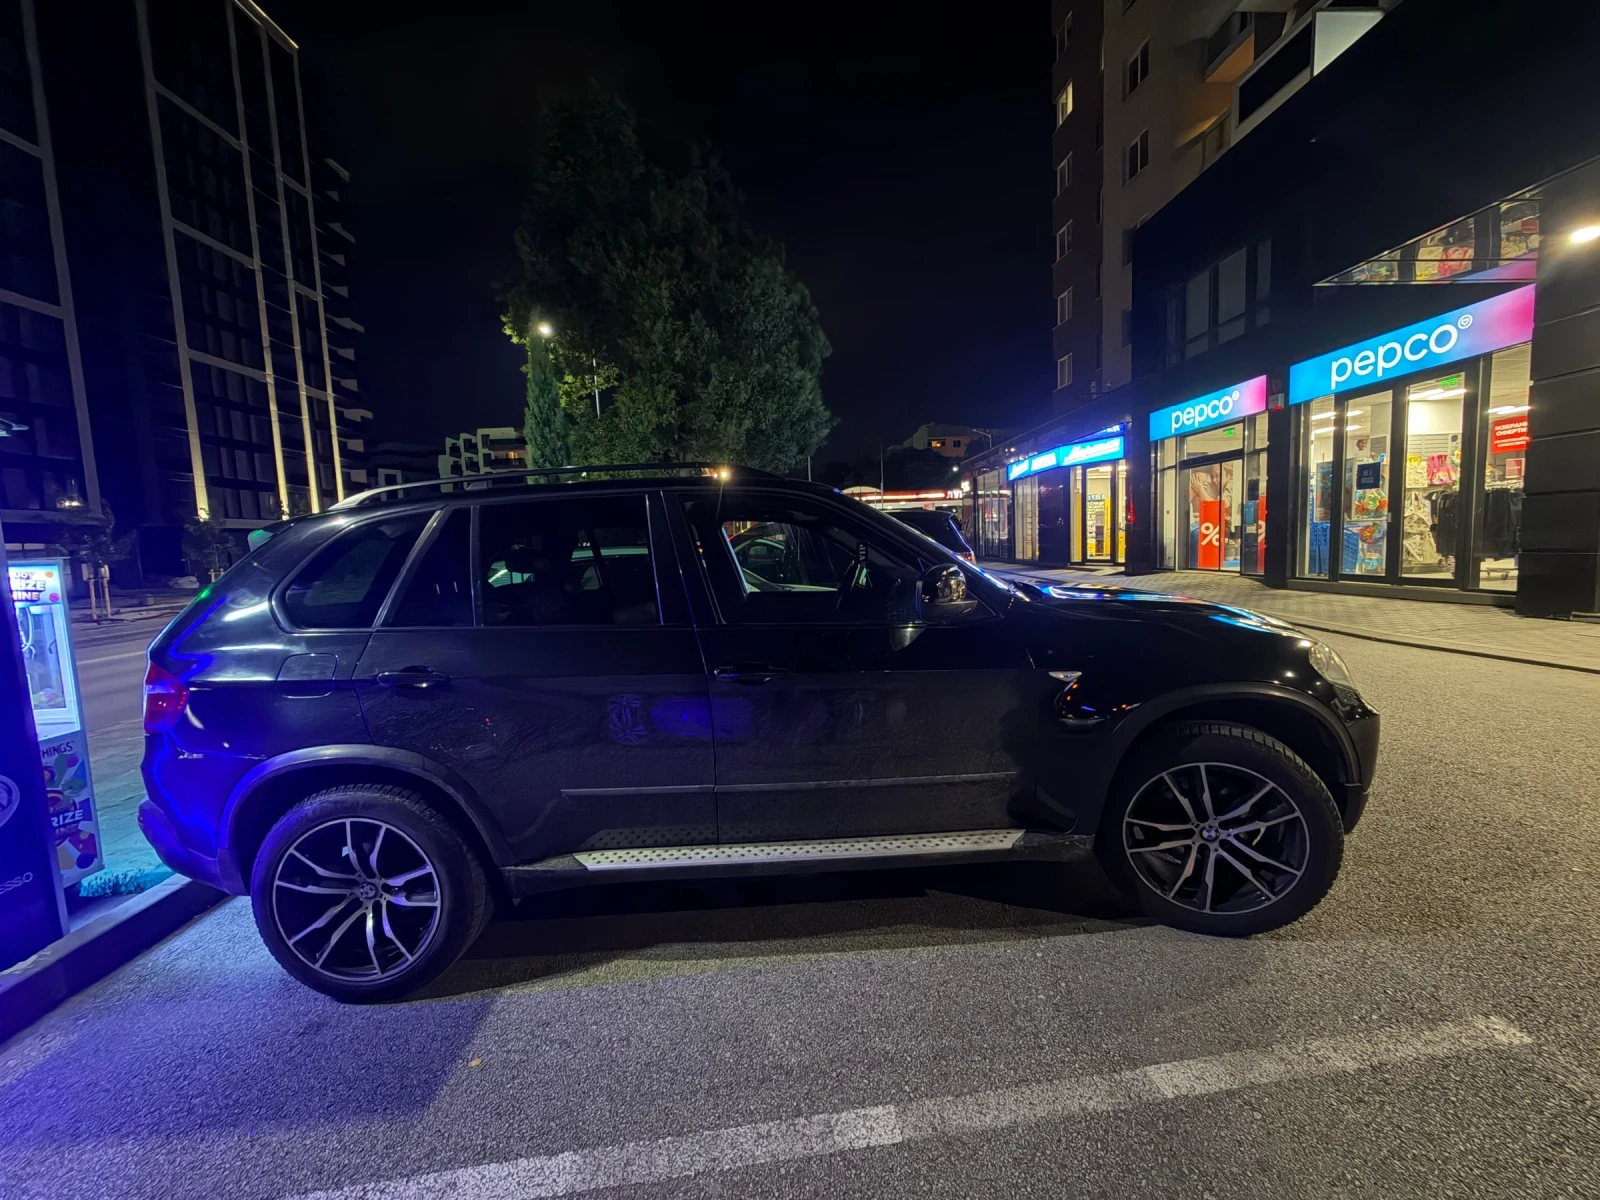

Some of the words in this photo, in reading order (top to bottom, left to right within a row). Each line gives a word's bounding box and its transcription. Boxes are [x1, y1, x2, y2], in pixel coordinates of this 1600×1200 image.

[1330, 324, 1458, 390] pepco
[1171, 395, 1234, 433] pepco
[13, 571, 36, 580] JOY
[40, 741, 74, 759] HINGS
[50, 809, 84, 827] RIZE
